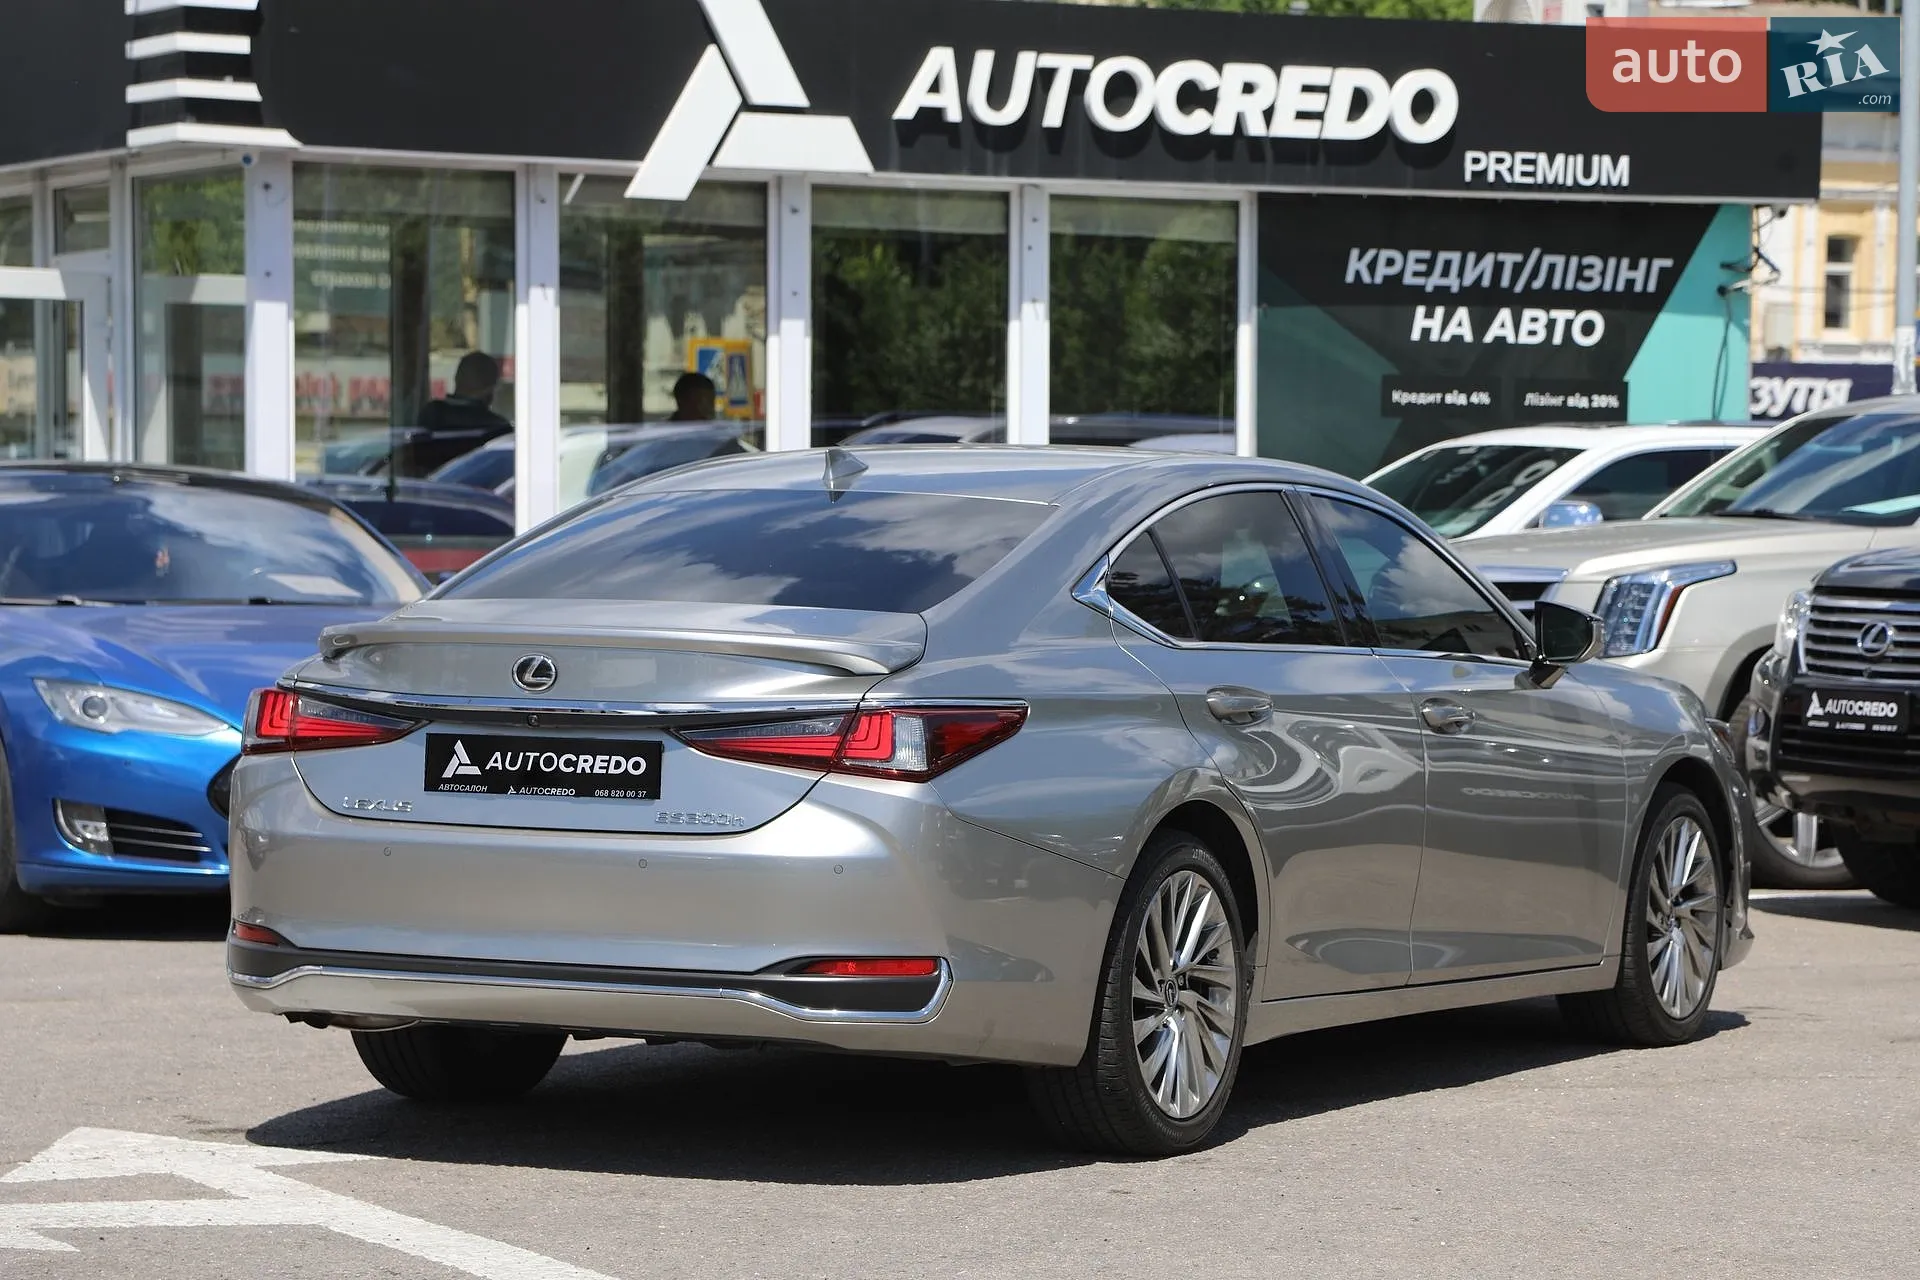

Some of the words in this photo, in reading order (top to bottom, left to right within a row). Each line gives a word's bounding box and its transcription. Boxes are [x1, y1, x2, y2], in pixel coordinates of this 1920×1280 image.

[892, 45, 1459, 144] AUTOCREDO
[1464, 150, 1630, 187] PREMIUM
[1345, 247, 1674, 293] КРЕДИТ/ЛІЗІНГ
[1410, 305, 1474, 343] НА
[1483, 307, 1606, 347] АВТО
[1392, 389, 1443, 407] Кредит
[1445, 389, 1468, 406] від
[1469, 390, 1491, 406] 4%
[1524, 392, 1565, 408] Лізінг
[1824, 699, 1898, 718] AUTOCREDO
[485, 751, 648, 776] AUTOCREDO
[438, 783, 488, 793] АВТОСАЛОН
[519, 786, 576, 796] AUTOCREDO
[594, 789, 609, 798] 068
[610, 790, 626, 799] 820
[626, 790, 638, 799] 00
[638, 790, 647, 799] 37
[342, 796, 413, 812] LEXUS
[655, 811, 744, 827] ES300h
